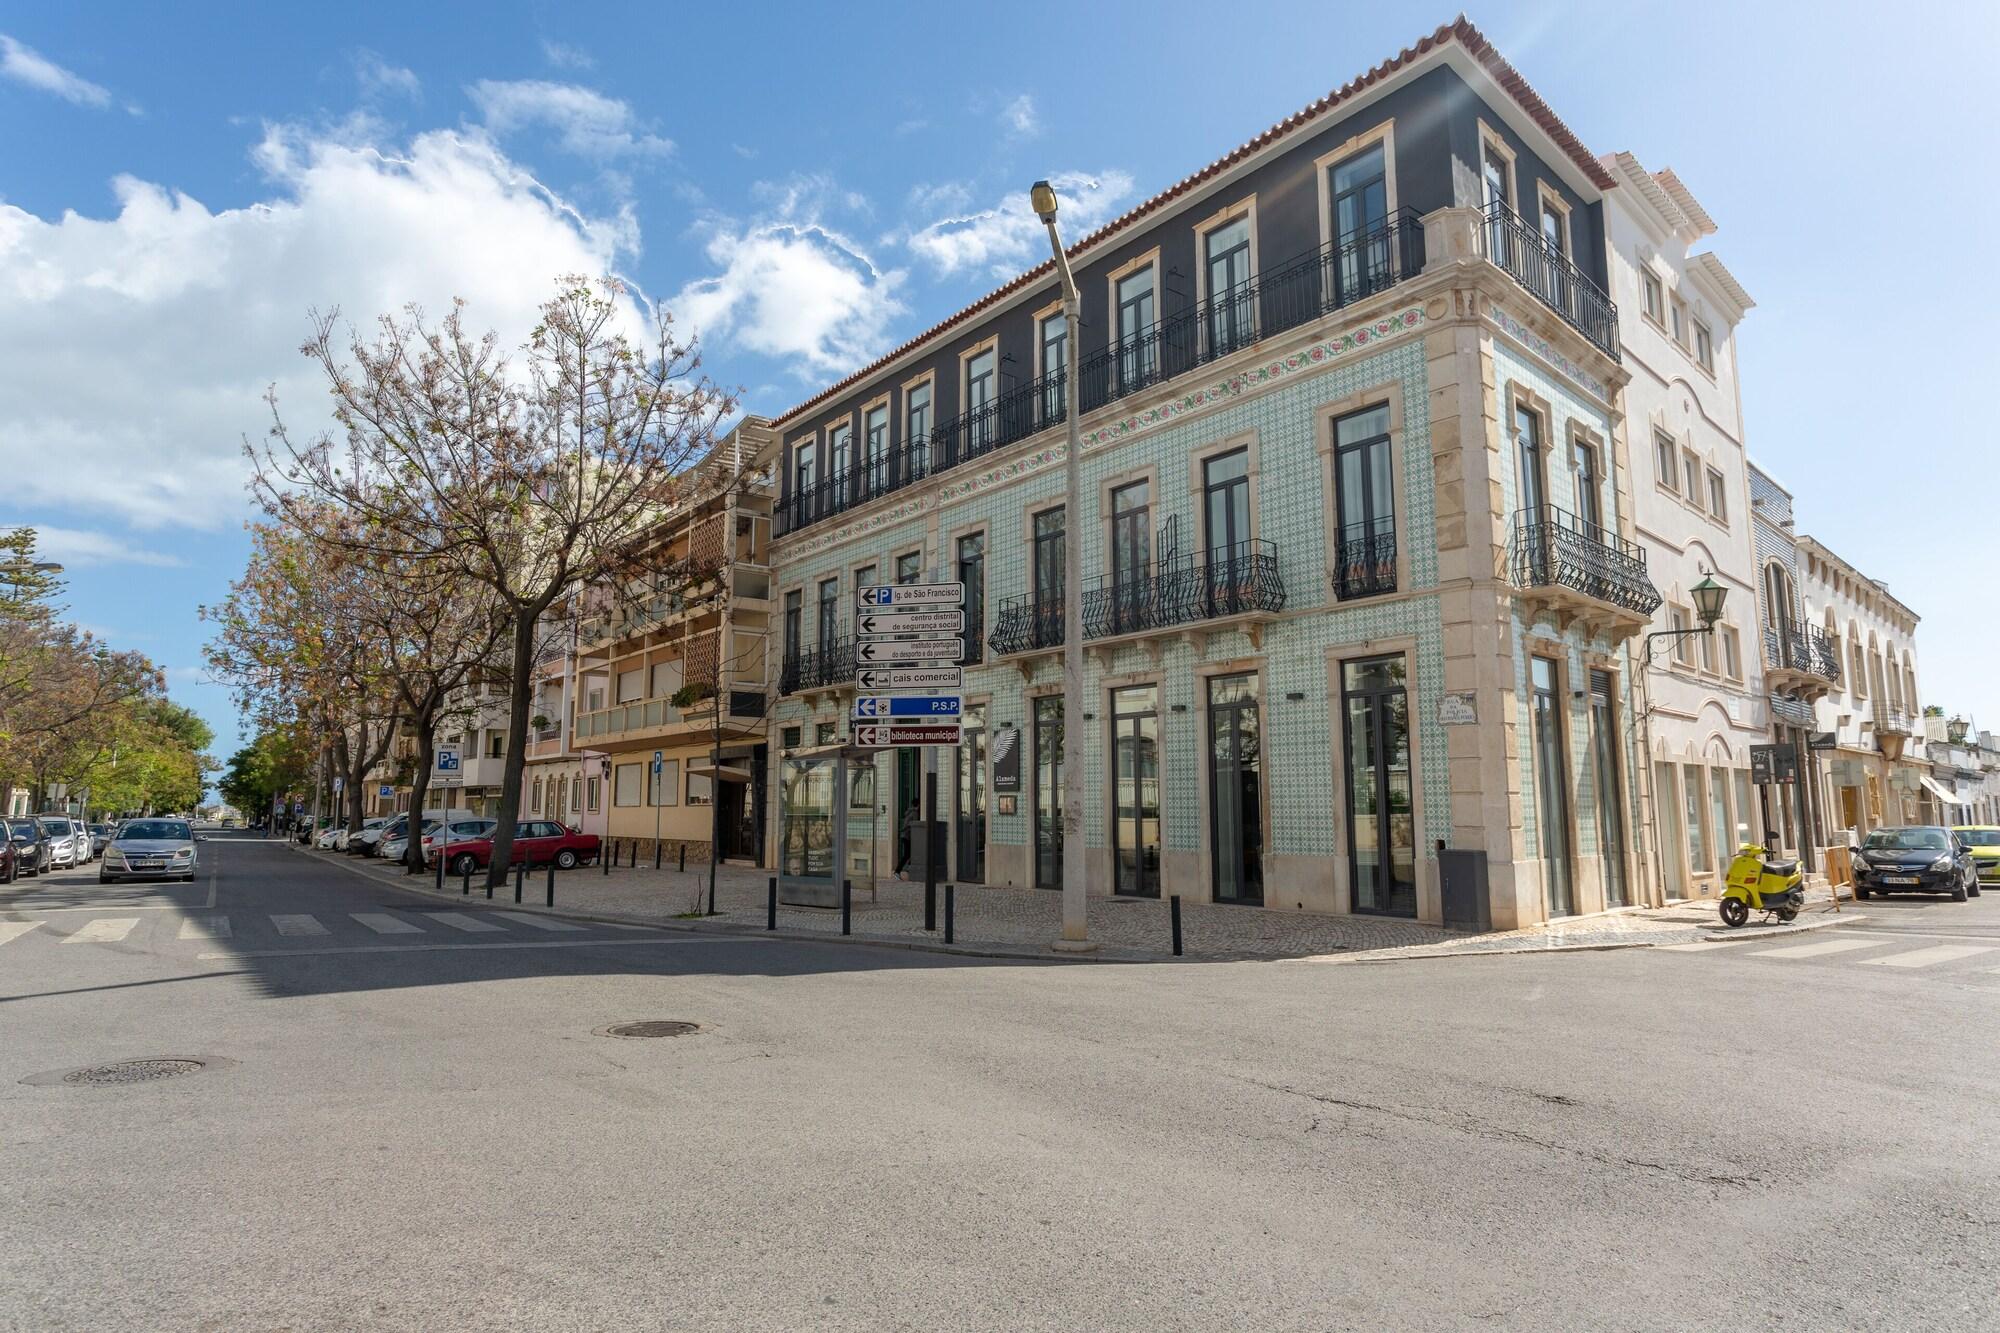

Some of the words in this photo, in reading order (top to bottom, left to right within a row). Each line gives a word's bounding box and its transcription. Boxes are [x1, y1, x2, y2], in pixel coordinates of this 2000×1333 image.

[904, 590, 912, 599] de
[913, 589, 926, 598] São
[927, 588, 959, 597] Francisco
[933, 612, 959, 620] distrital
[892, 623, 900, 631] de
[901, 623, 937, 631] segurança
[938, 621, 959, 629] social
[932, 641, 959, 649] português
[899, 651, 921, 659] desporto
[933, 649, 959, 659] juventude
[893, 674, 912, 683] cais
[914, 671, 959, 681] comercial
[931, 701, 959, 711] P.S.P.
[891, 731, 924, 741] biblioteca
[925, 730, 959, 741] municipal
